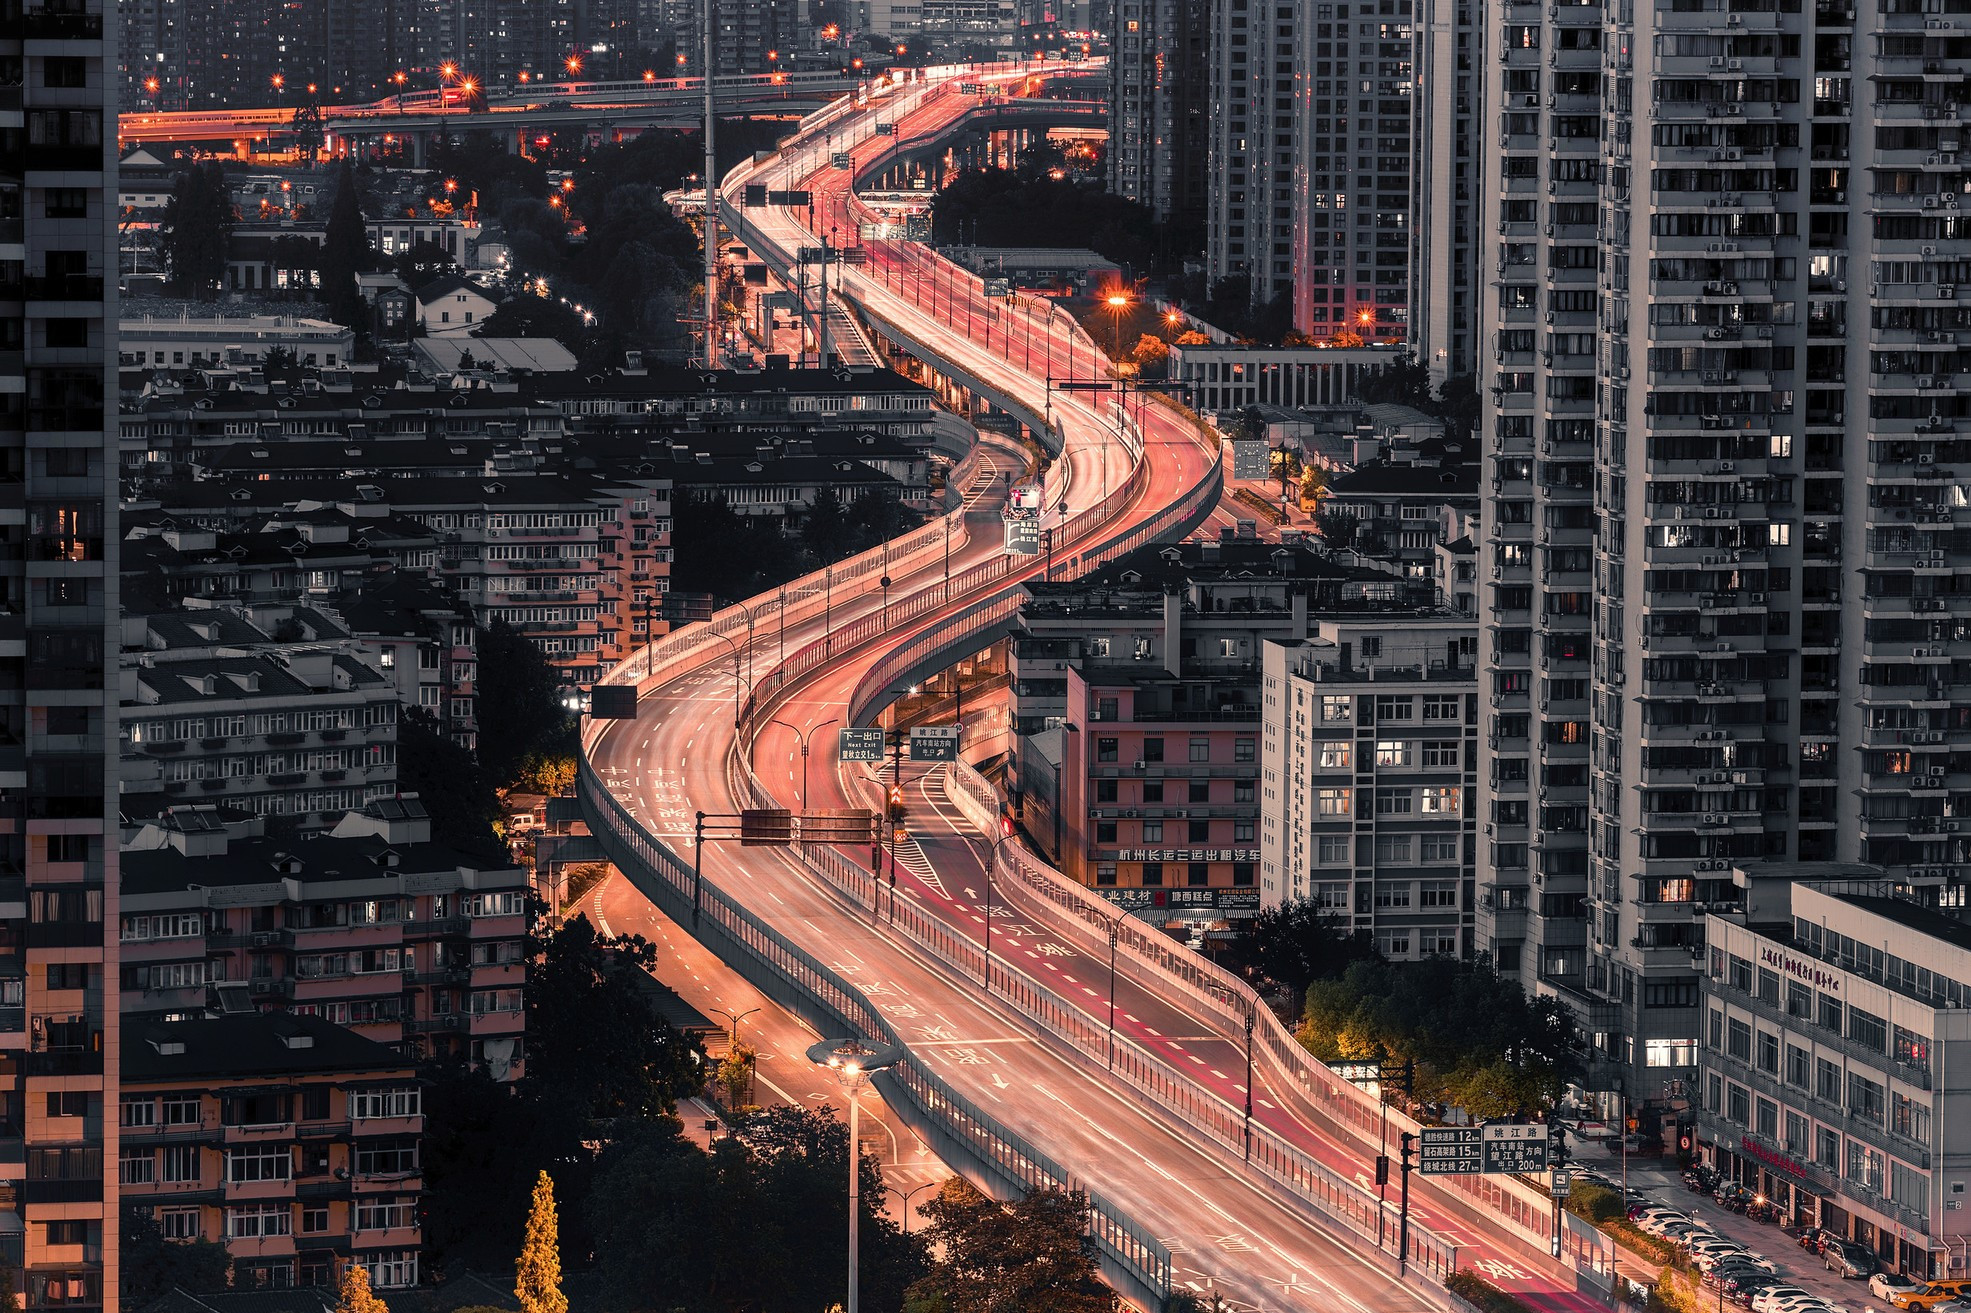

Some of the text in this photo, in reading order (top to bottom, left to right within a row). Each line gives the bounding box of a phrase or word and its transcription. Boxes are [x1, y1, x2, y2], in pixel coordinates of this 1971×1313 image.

[843, 731, 881, 741] 下一出口
[1119, 849, 1260, 861] 杭州长运三运出租汽车
[1424, 1132, 1455, 1142] 德胜快速路
[1494, 1127, 1537, 1138] 姚江路
[1490, 1141, 1525, 1151] 汽车南站
[1526, 1146, 1542, 1156] 方向
[1423, 1146, 1456, 1157] 留石高架路
[1490, 1151, 1524, 1161] 望江路
[1423, 1161, 1456, 1172] 绕城北线
